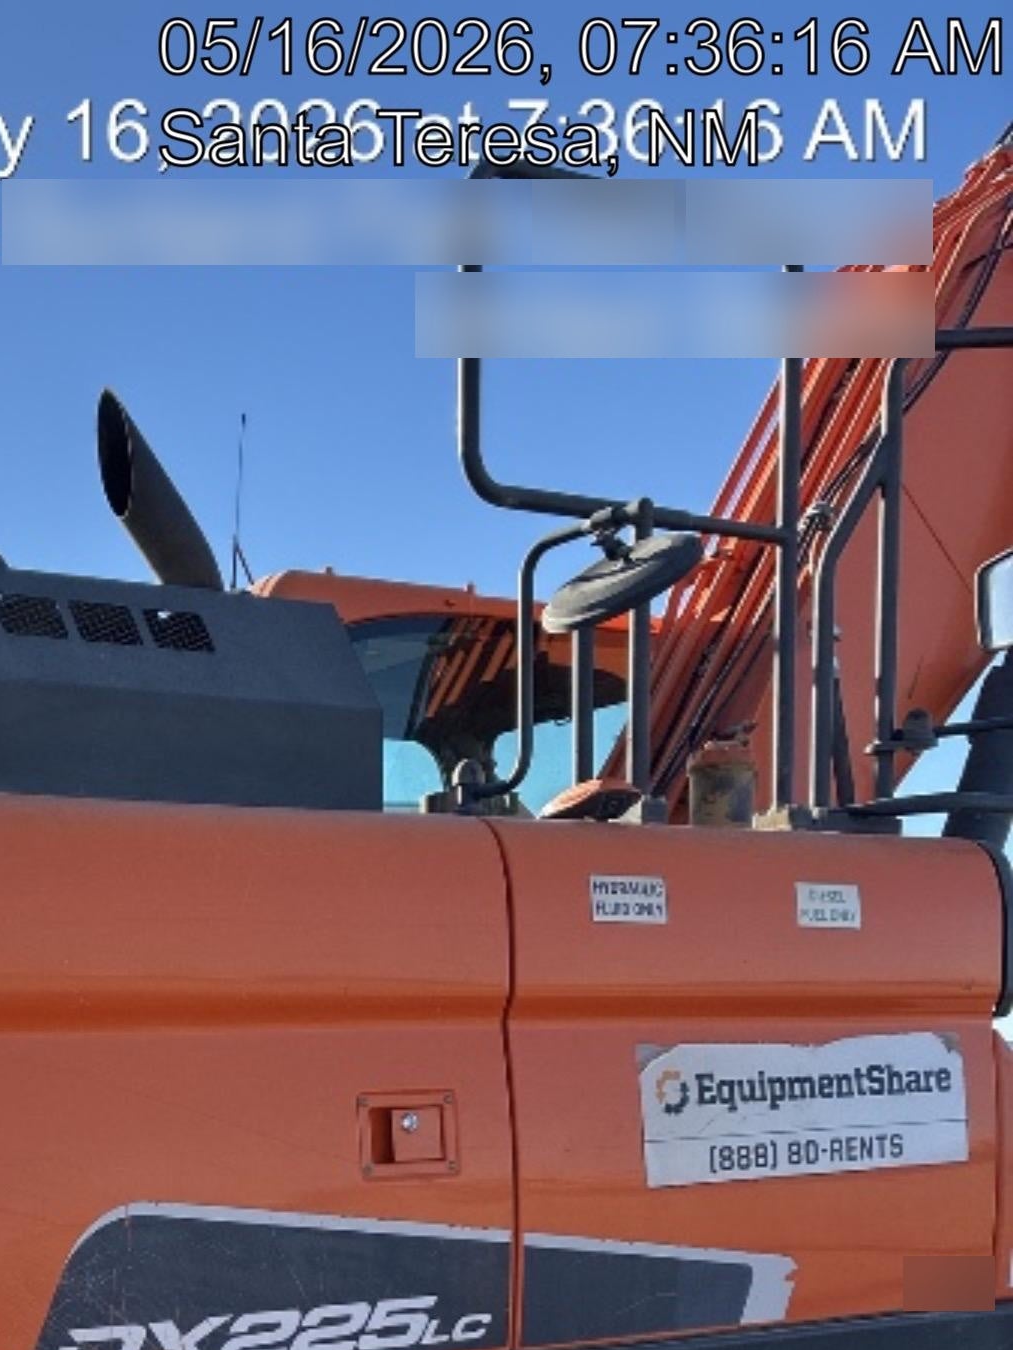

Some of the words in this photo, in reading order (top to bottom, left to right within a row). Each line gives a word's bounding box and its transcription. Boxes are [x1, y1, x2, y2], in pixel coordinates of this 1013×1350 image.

[694, 1064, 952, 1112] EquipmentShare
[709, 1139, 778, 1173] (888)
[787, 1133, 904, 1166] 80-RENTS
